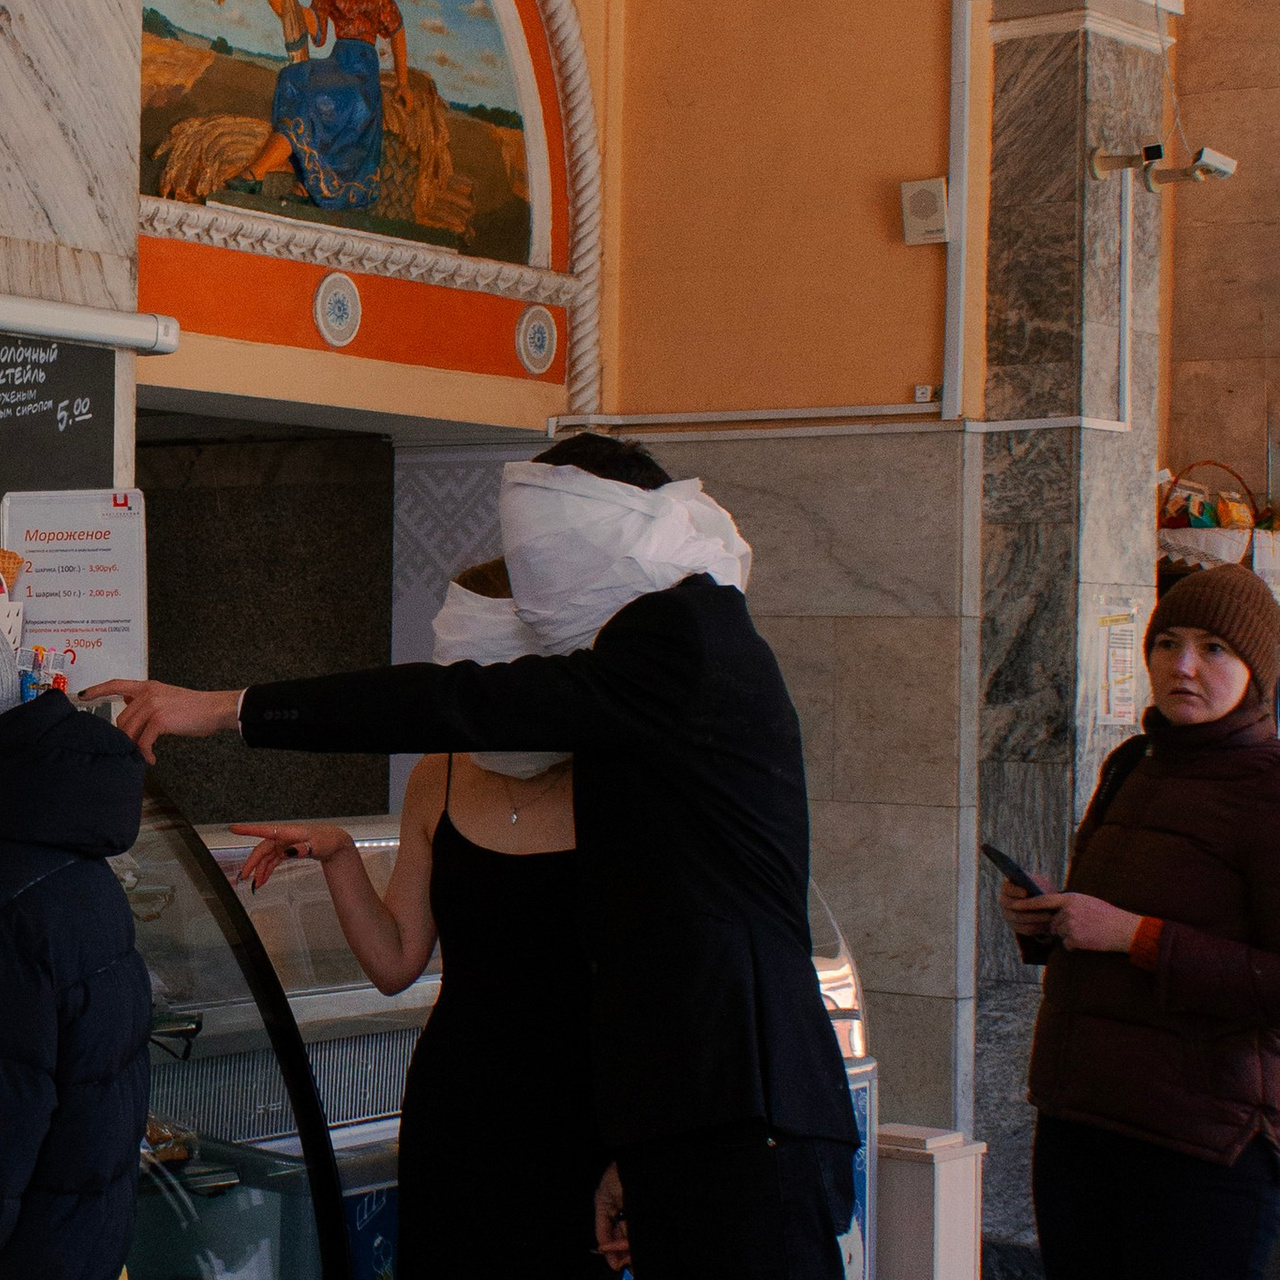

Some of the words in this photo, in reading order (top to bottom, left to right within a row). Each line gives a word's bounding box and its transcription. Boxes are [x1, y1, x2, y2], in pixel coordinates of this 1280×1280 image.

[24, 529, 111, 544] Мороженое
[25, 561, 33, 573] 2
[26, 585, 33, 598] 1
[65, 637, 103, 648] 3,90руб
